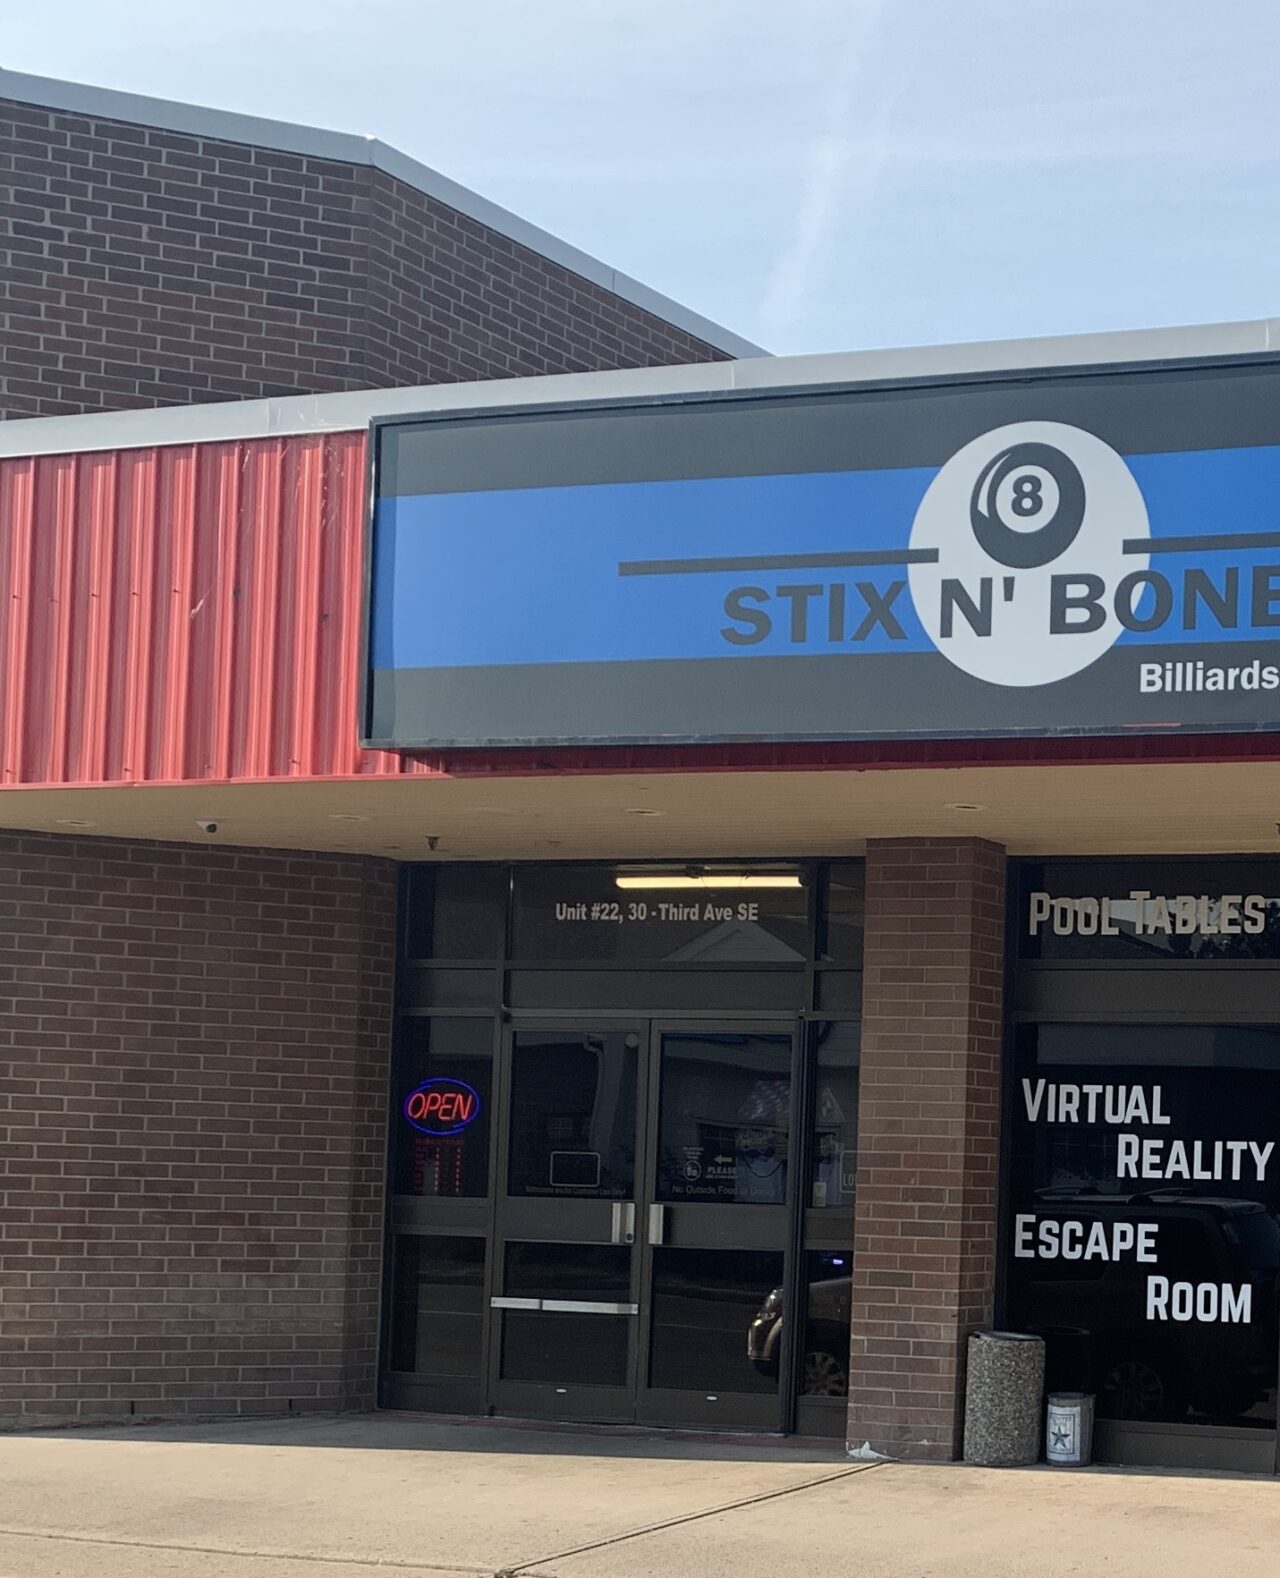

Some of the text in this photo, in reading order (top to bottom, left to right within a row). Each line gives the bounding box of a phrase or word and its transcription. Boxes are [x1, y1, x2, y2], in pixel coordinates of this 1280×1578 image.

[1011, 474, 1043, 517] 8
[720, 580, 908, 646] STIX
[939, 576, 1016, 639] N'
[1139, 659, 1280, 693] Billiards
[555, 903, 587, 921] Unit
[590, 903, 625, 925] #22,
[628, 903, 648, 921] 30
[703, 903, 733, 921] Ave
[737, 903, 759, 921] SE
[1029, 889, 1266, 936] POOL TABLES
[407, 1091, 473, 1121] OPEN
[1022, 1078, 1171, 1125] VIRTUAL
[1116, 1133, 1275, 1181] REALITY
[1014, 1213, 1159, 1263] ESCAPE
[1146, 1275, 1252, 1324] ROOM
